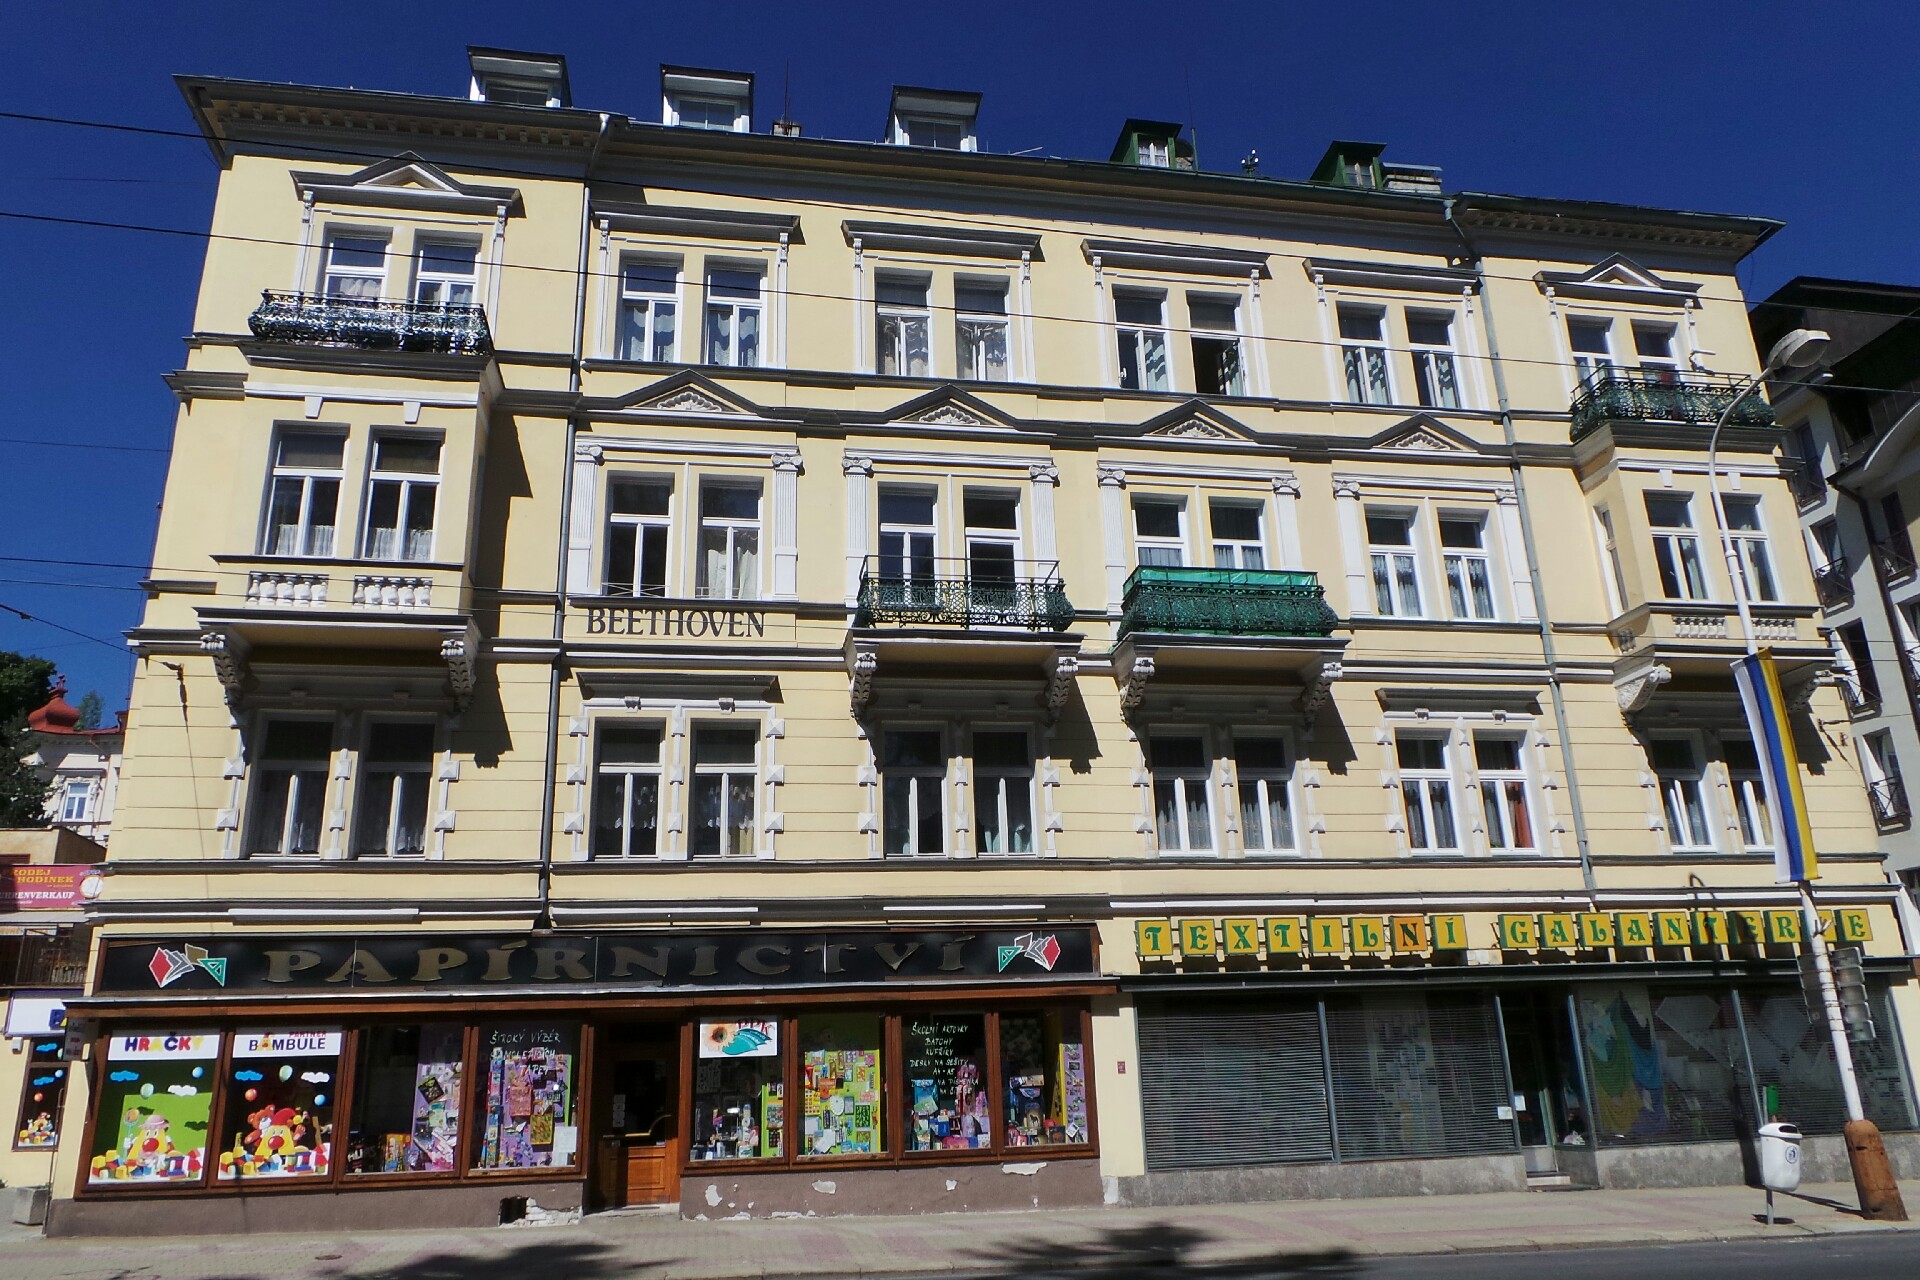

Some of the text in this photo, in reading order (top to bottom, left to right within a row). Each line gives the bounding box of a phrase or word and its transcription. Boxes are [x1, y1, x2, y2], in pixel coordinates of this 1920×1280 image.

[587, 608, 765, 637] BEETHOVEN
[1144, 917, 1457, 951] TEXTILNÍ
[261, 935, 976, 983] PAPÍRNICTVÍ
[124, 1032, 205, 1052] HRAČKY
[248, 1037, 326, 1051] BAMBULE
[925, 1037, 953, 1046] BATOHY
